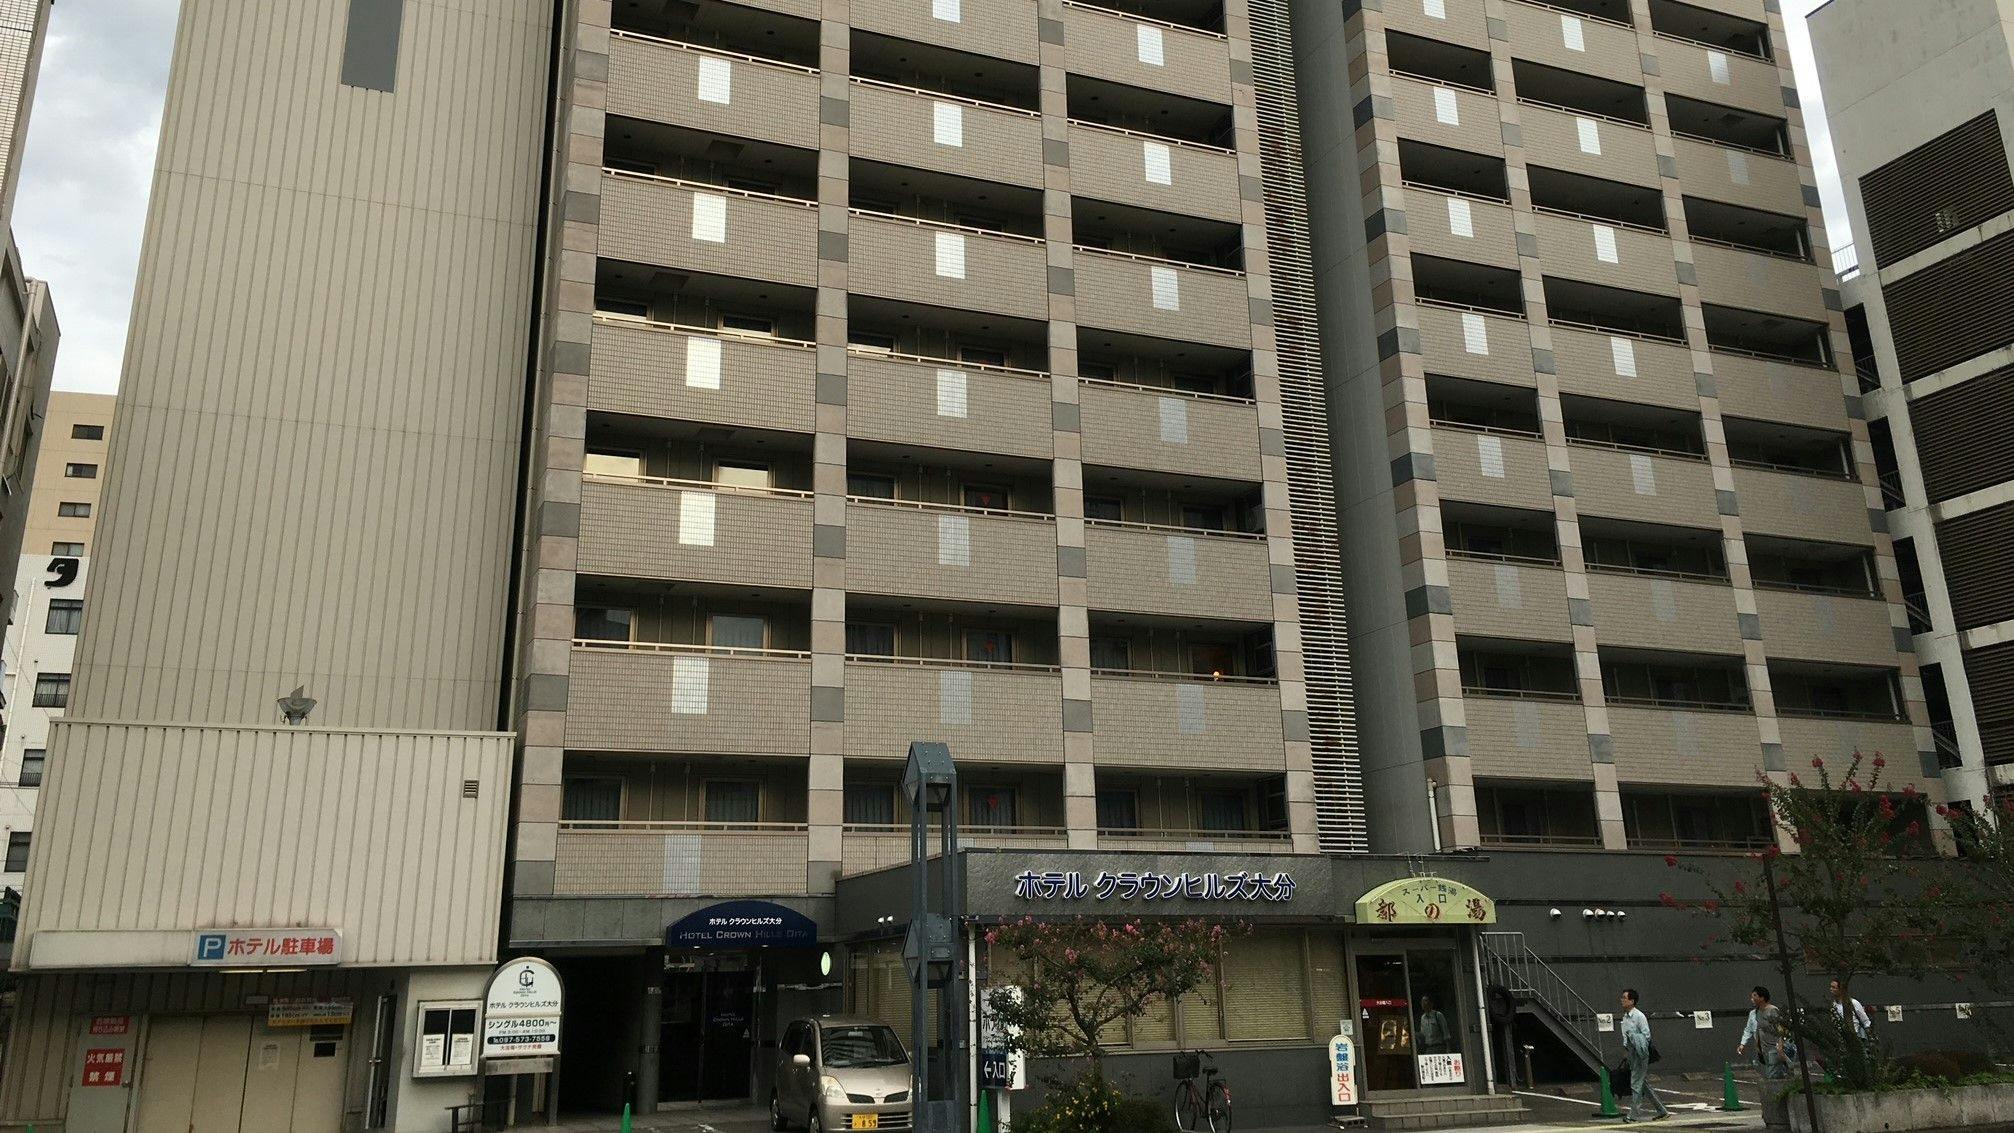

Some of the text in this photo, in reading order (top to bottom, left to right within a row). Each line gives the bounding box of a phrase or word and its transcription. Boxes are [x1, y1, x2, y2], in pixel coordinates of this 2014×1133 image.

[1014, 870, 1297, 901] ホテル クラウンヒルズ大分
[729, 917, 782, 925] クラウンヒルズ大分
[680, 931, 712, 940] HOTEL
[716, 930, 751, 939] CROWN
[203, 937, 334, 958] P ホテル駐車場
[489, 1000, 559, 1009] ホテル クラウンヒルズ大分
[993, 1061, 1006, 1079] 入口
